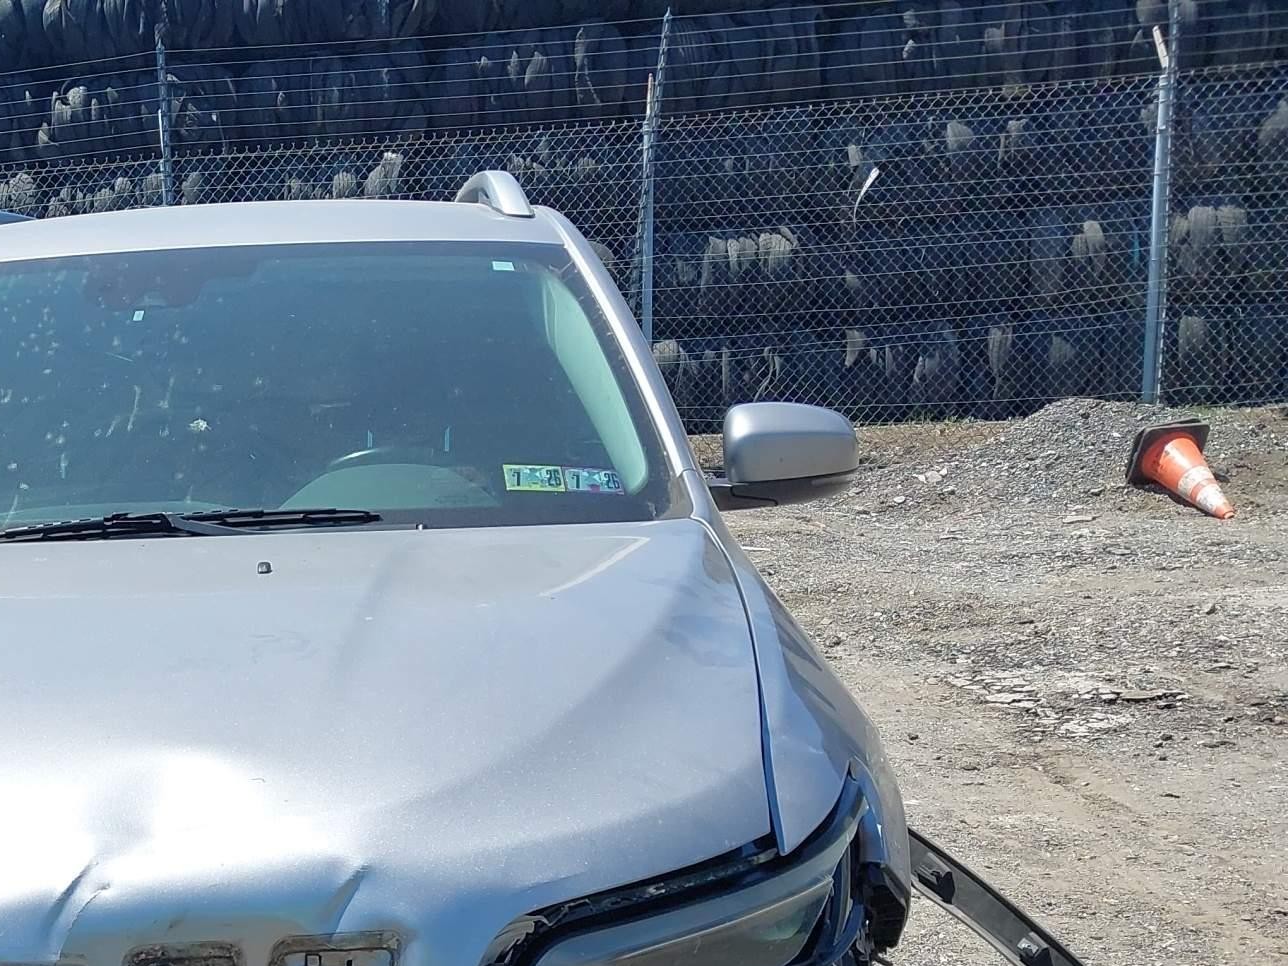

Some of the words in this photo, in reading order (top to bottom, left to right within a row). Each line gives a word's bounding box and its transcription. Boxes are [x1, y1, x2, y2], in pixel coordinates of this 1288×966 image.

[512, 471, 521, 486] 7
[546, 469, 562, 486] 26
[571, 473, 580, 489] 7
[603, 472, 620, 489] 26
